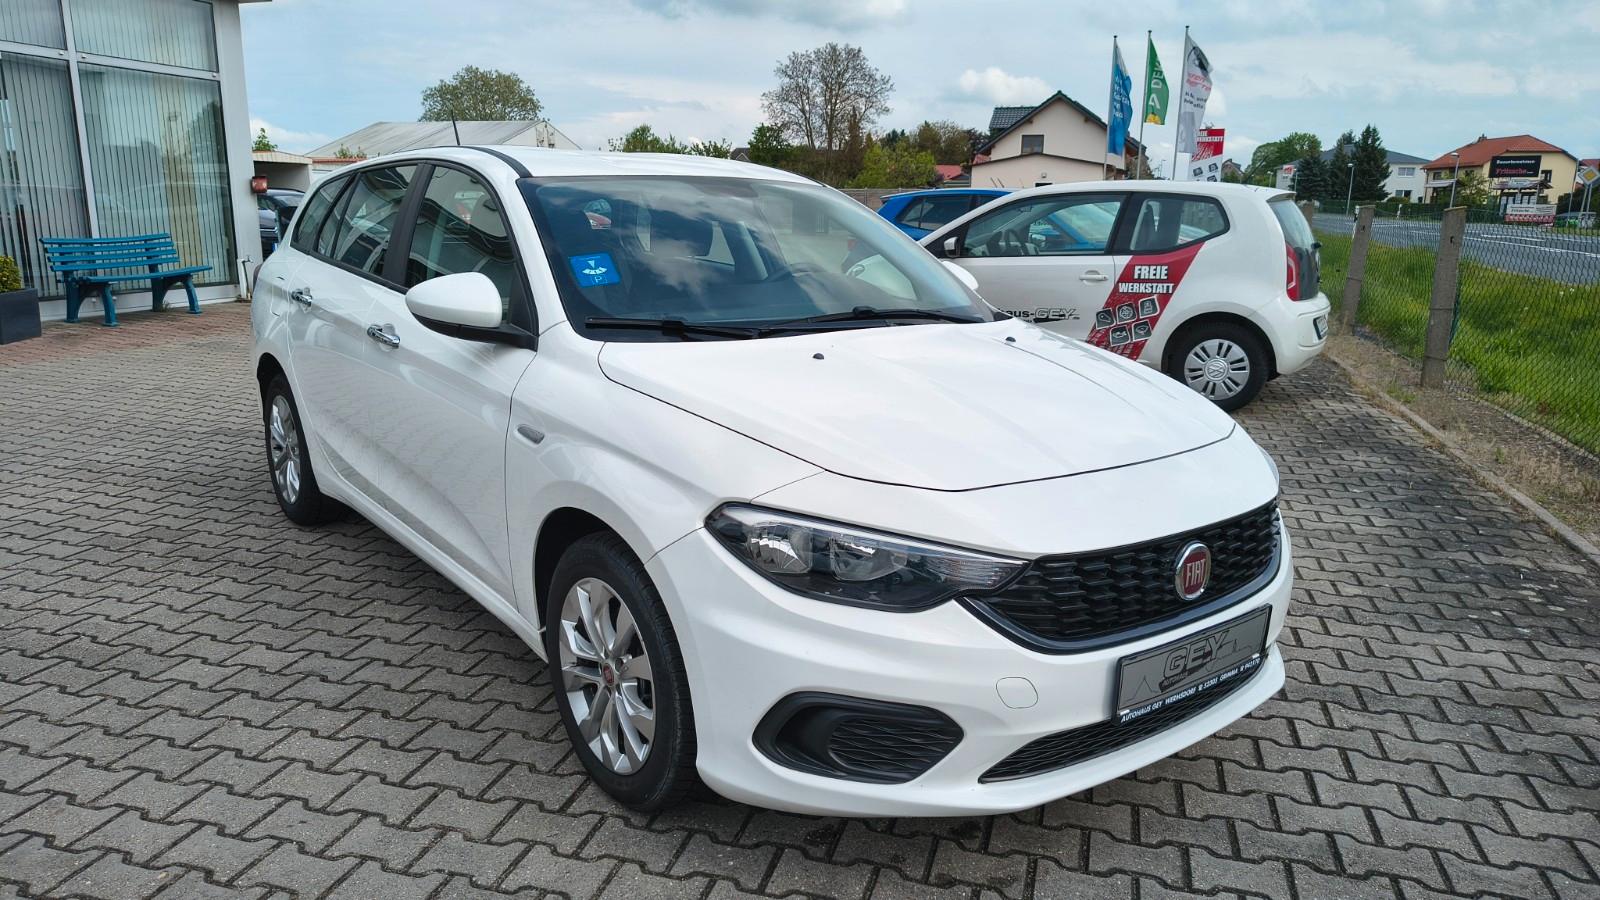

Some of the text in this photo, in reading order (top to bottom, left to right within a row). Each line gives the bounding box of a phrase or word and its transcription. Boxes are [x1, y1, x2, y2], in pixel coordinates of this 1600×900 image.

[1134, 265, 1168, 280] FREIE
[1118, 282, 1174, 294] WERKSTATT
[1185, 558, 1206, 588] FIAT
[1163, 629, 1230, 679] GEY
[1120, 704, 1151, 723] AUTOHAUS
[1151, 700, 1163, 710] GEY
